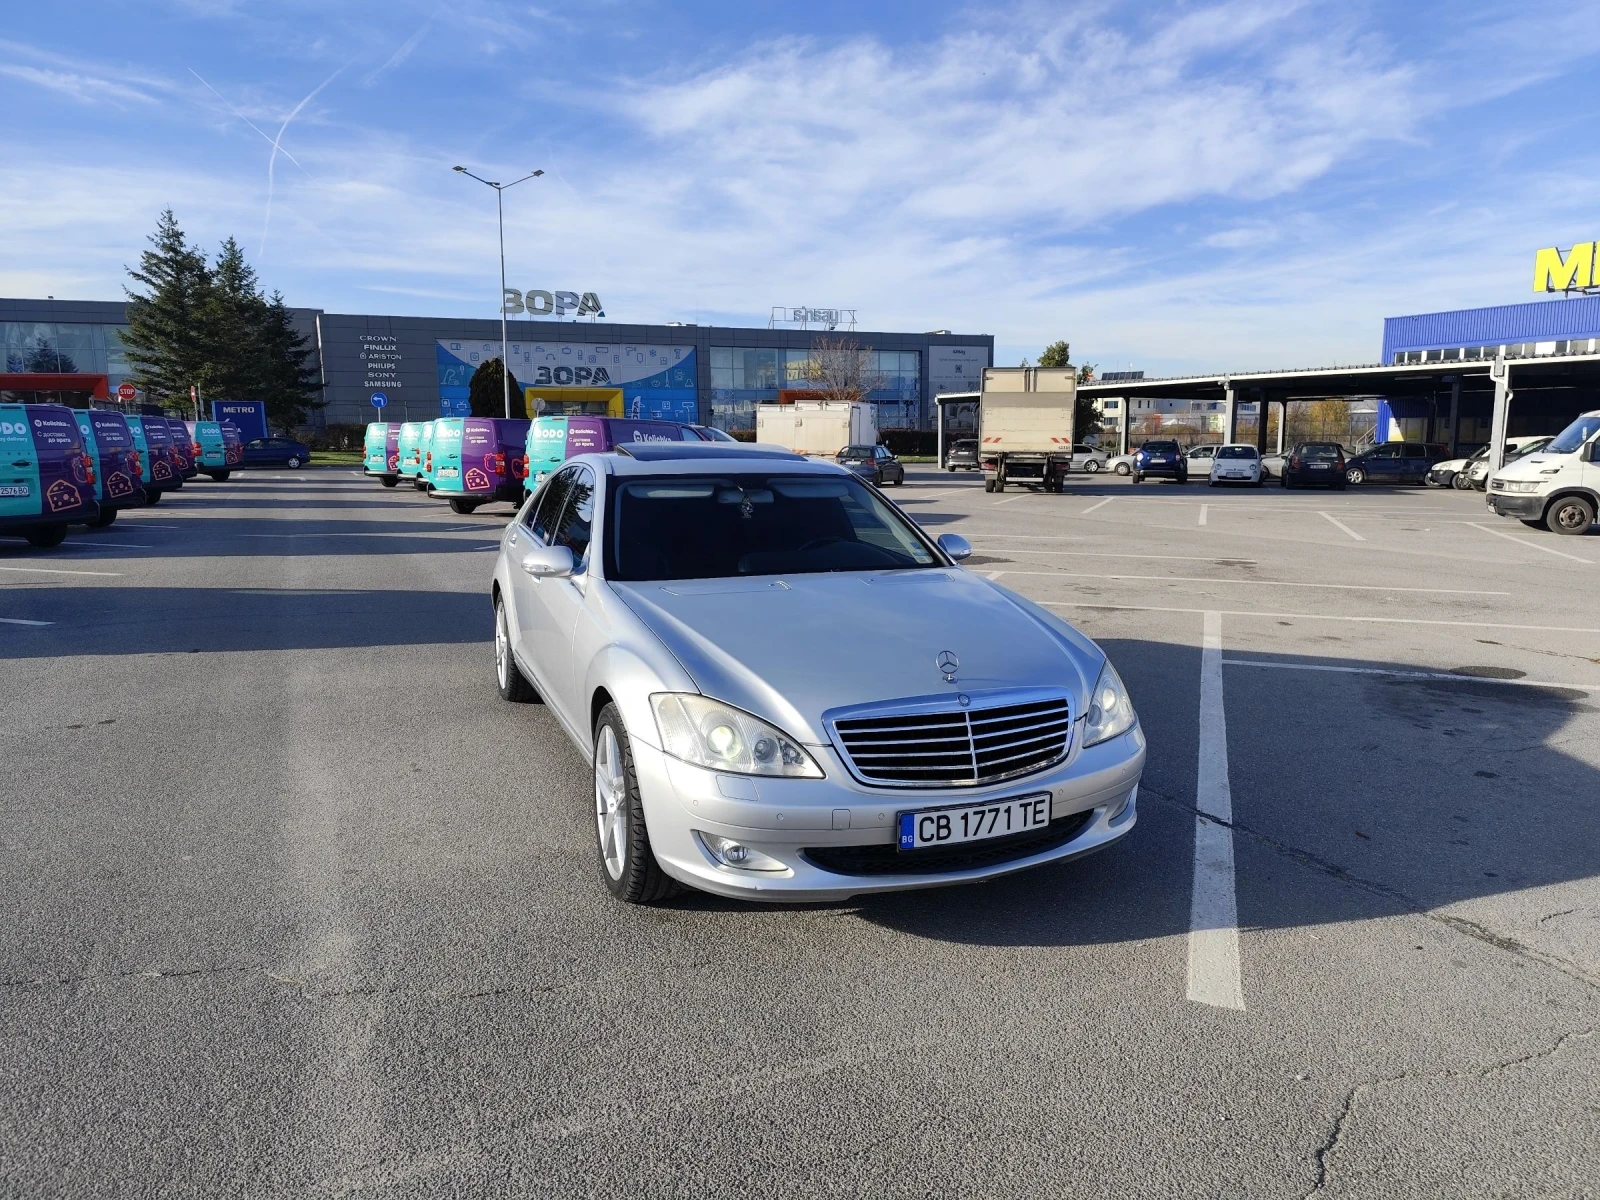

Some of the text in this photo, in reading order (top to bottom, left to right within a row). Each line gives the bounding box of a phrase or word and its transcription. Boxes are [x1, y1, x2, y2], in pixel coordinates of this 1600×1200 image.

[1533, 241, 1600, 292] M
[500, 288, 604, 317] ЗОРА
[794, 306, 838, 327] sinsay
[364, 380, 402, 388] SAMSUNG
[534, 366, 612, 385] ЗОРА
[0, 422, 27, 435] DO
[919, 799, 1046, 842] CB 1771 TE
[901, 835, 913, 843] BG
